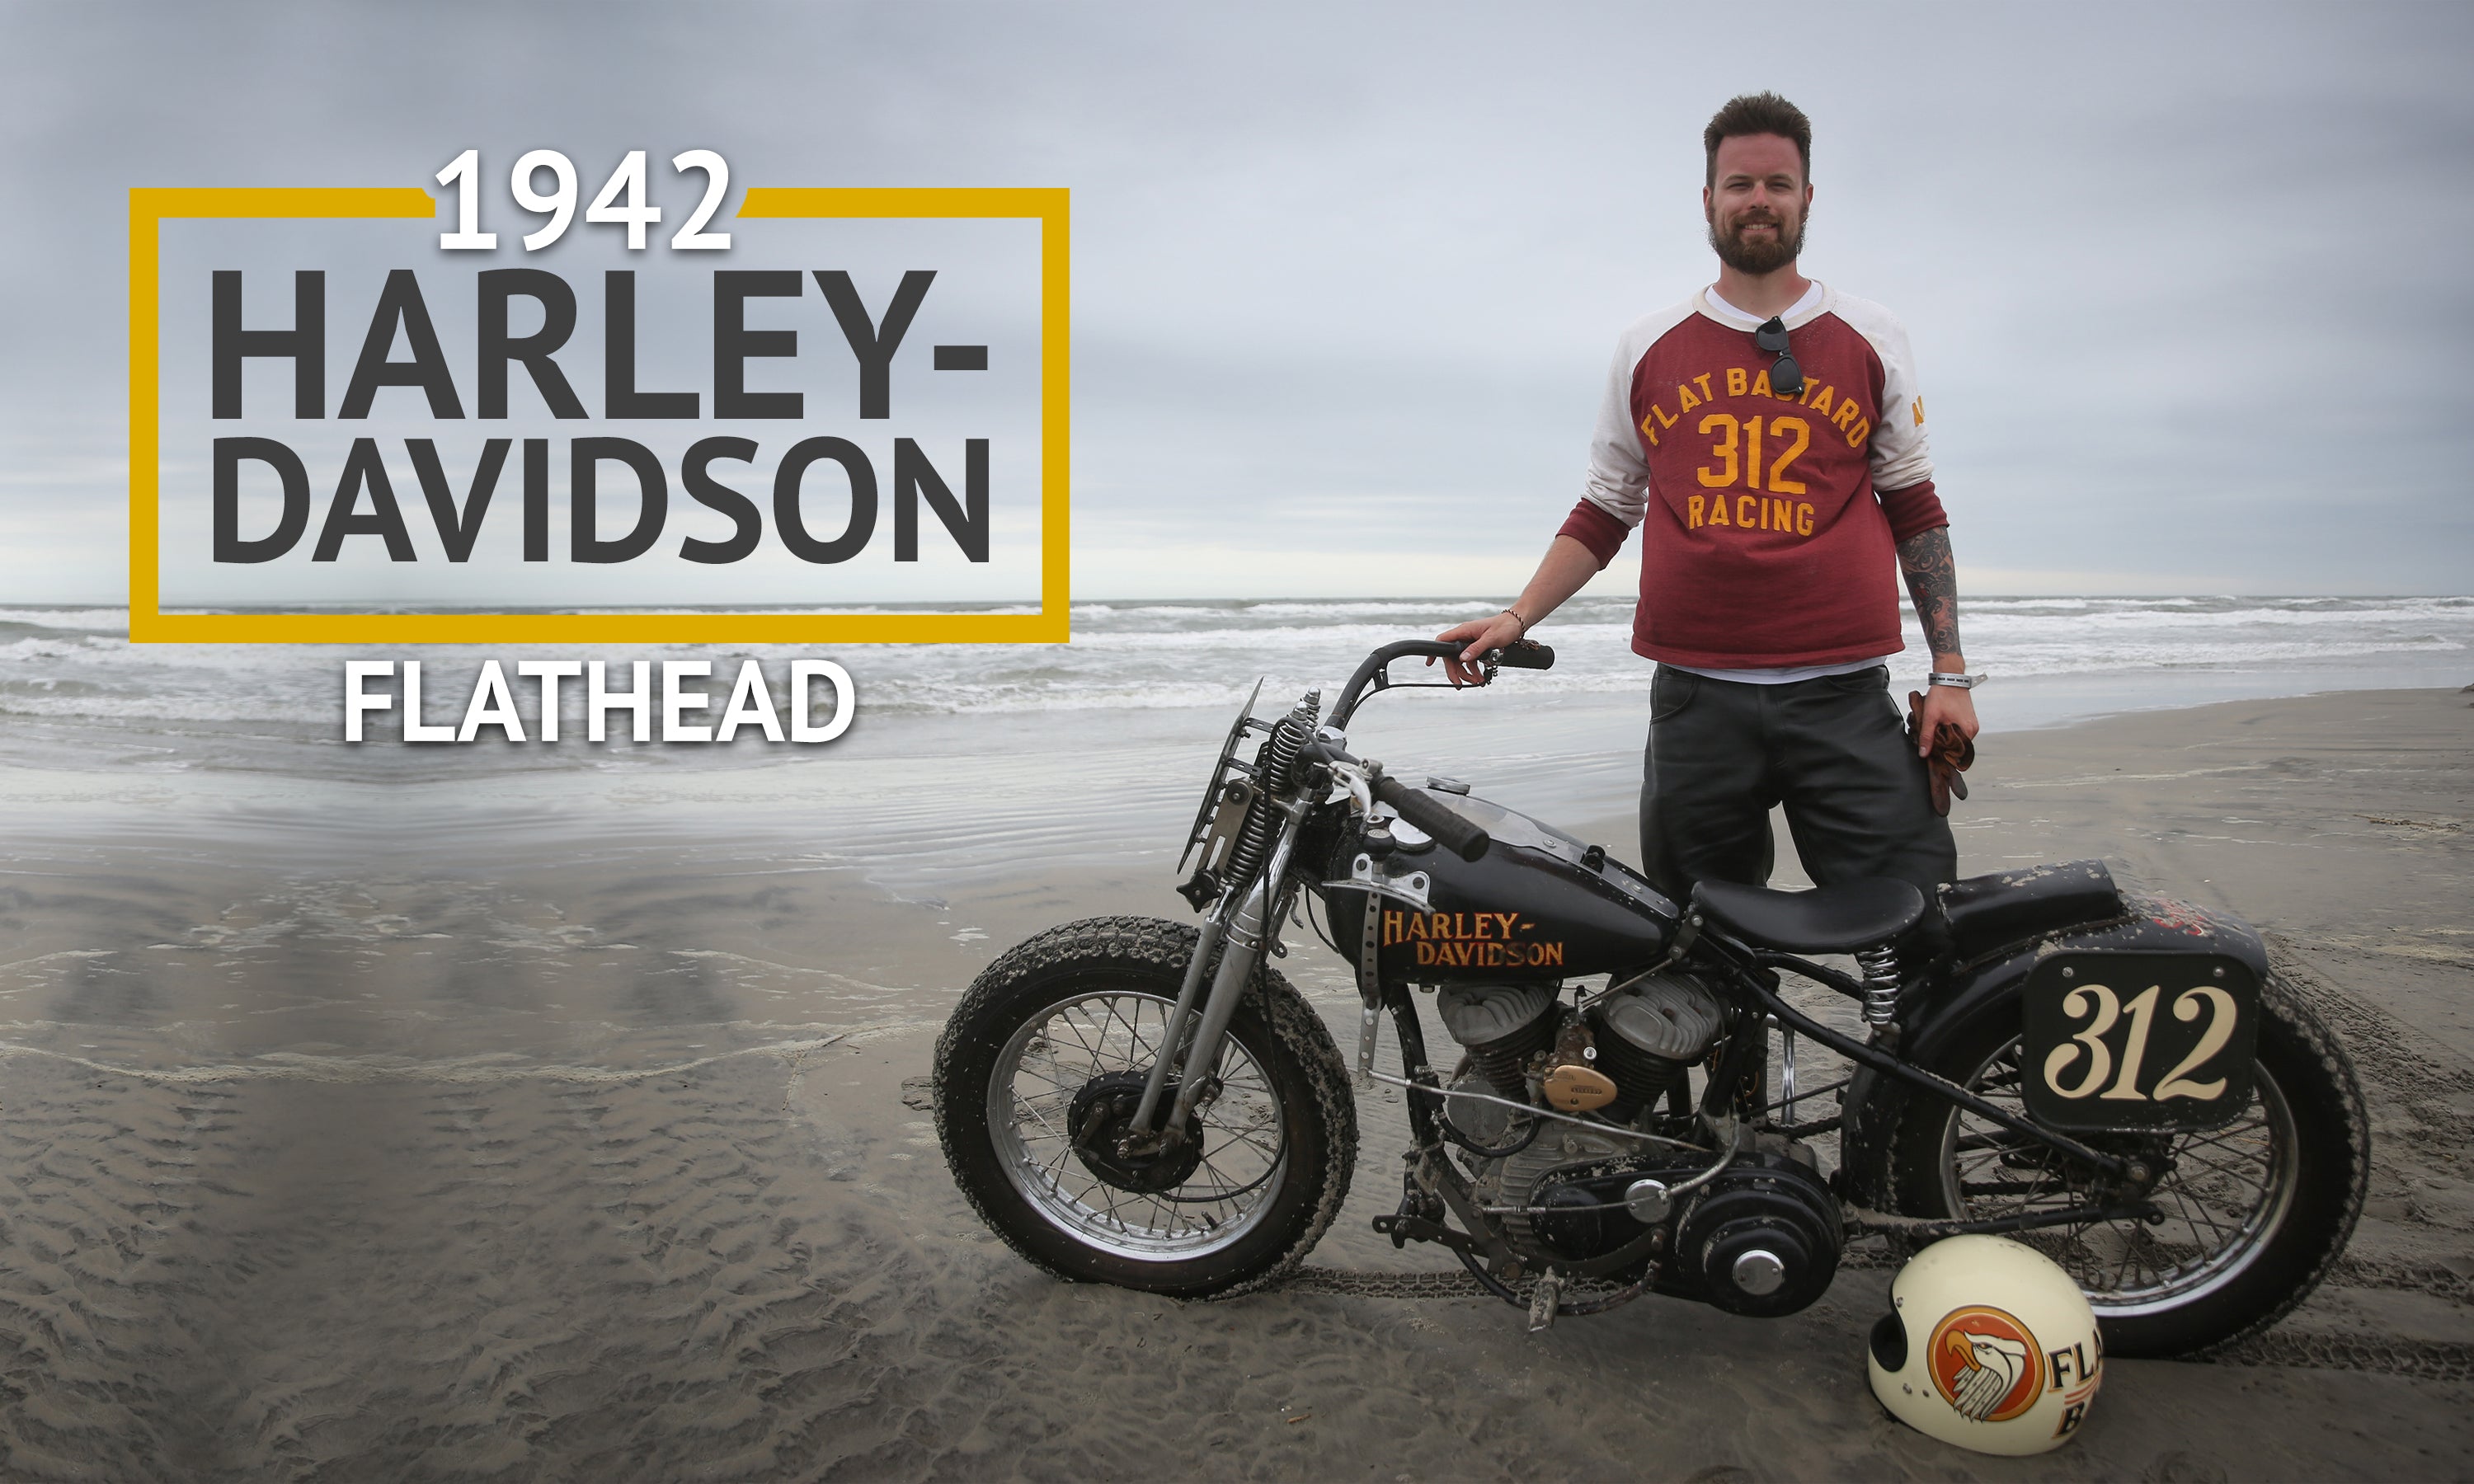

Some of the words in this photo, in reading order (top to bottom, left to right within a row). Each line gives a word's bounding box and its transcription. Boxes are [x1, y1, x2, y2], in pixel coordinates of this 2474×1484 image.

[1640, 373, 1714, 446] FLAT
[1727, 368, 1870, 448] BATARD
[1697, 414, 1810, 495] 312
[1688, 495, 1815, 537] RACING
[1383, 910, 1536, 946] HARLEY-
[1416, 941, 1564, 967] DAVIDSON
[2044, 984, 2237, 1102] 312
